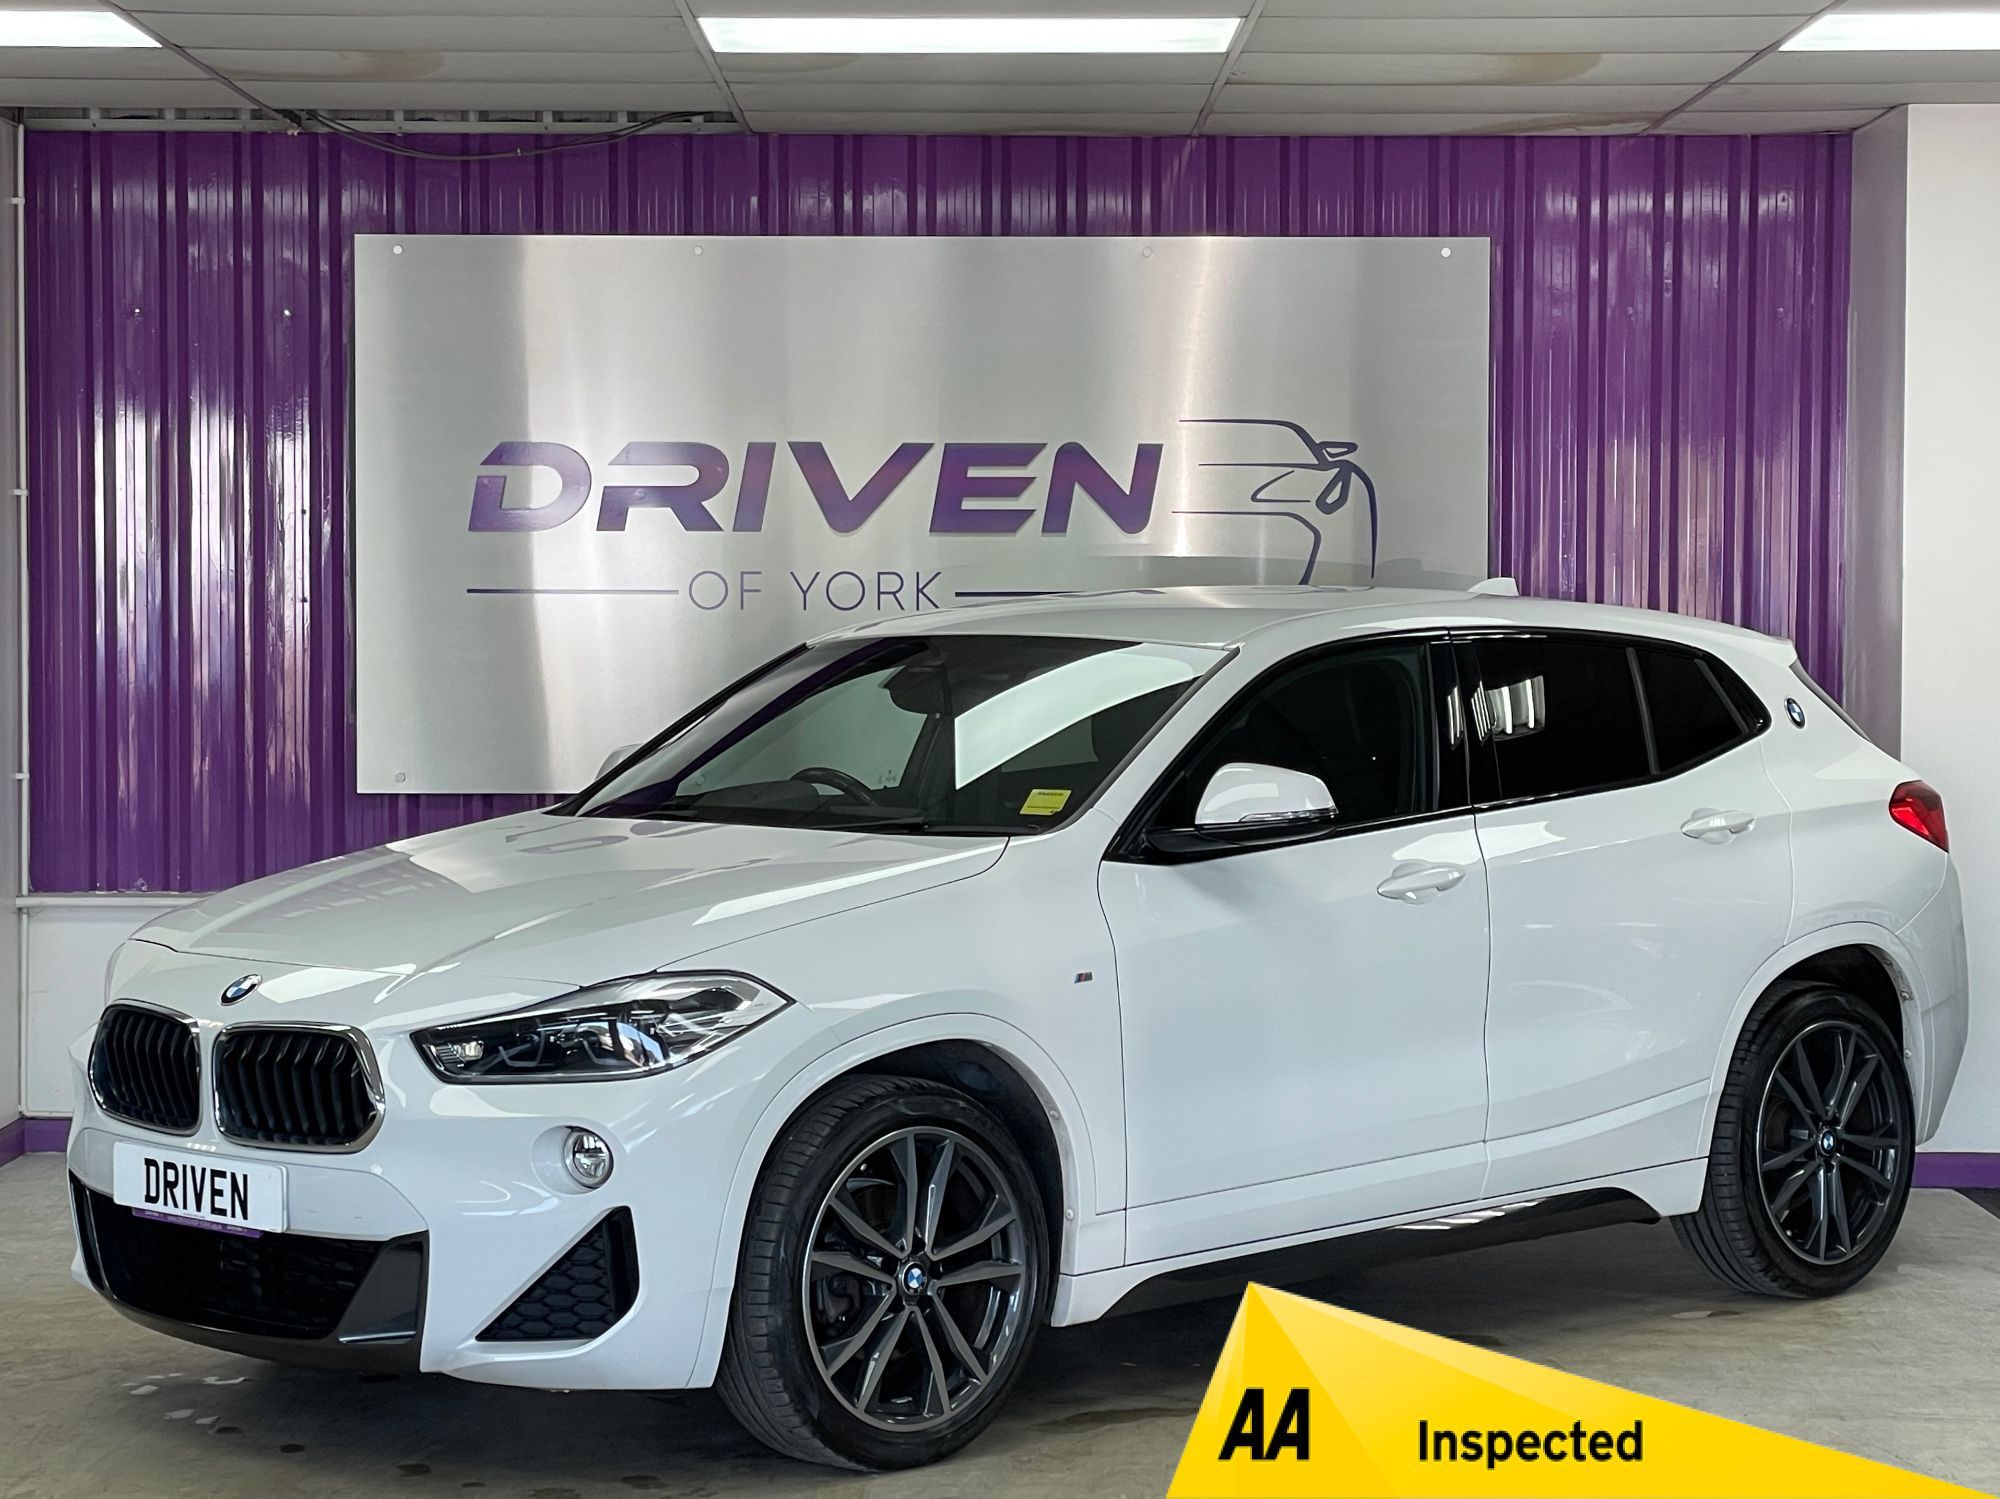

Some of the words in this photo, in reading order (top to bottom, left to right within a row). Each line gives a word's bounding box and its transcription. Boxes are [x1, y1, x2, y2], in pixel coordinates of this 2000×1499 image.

[467, 441, 1164, 535] DRIVEN
[688, 571, 763, 610] OF
[790, 571, 942, 610] YORK
[144, 1157, 249, 1220] DRIVEN
